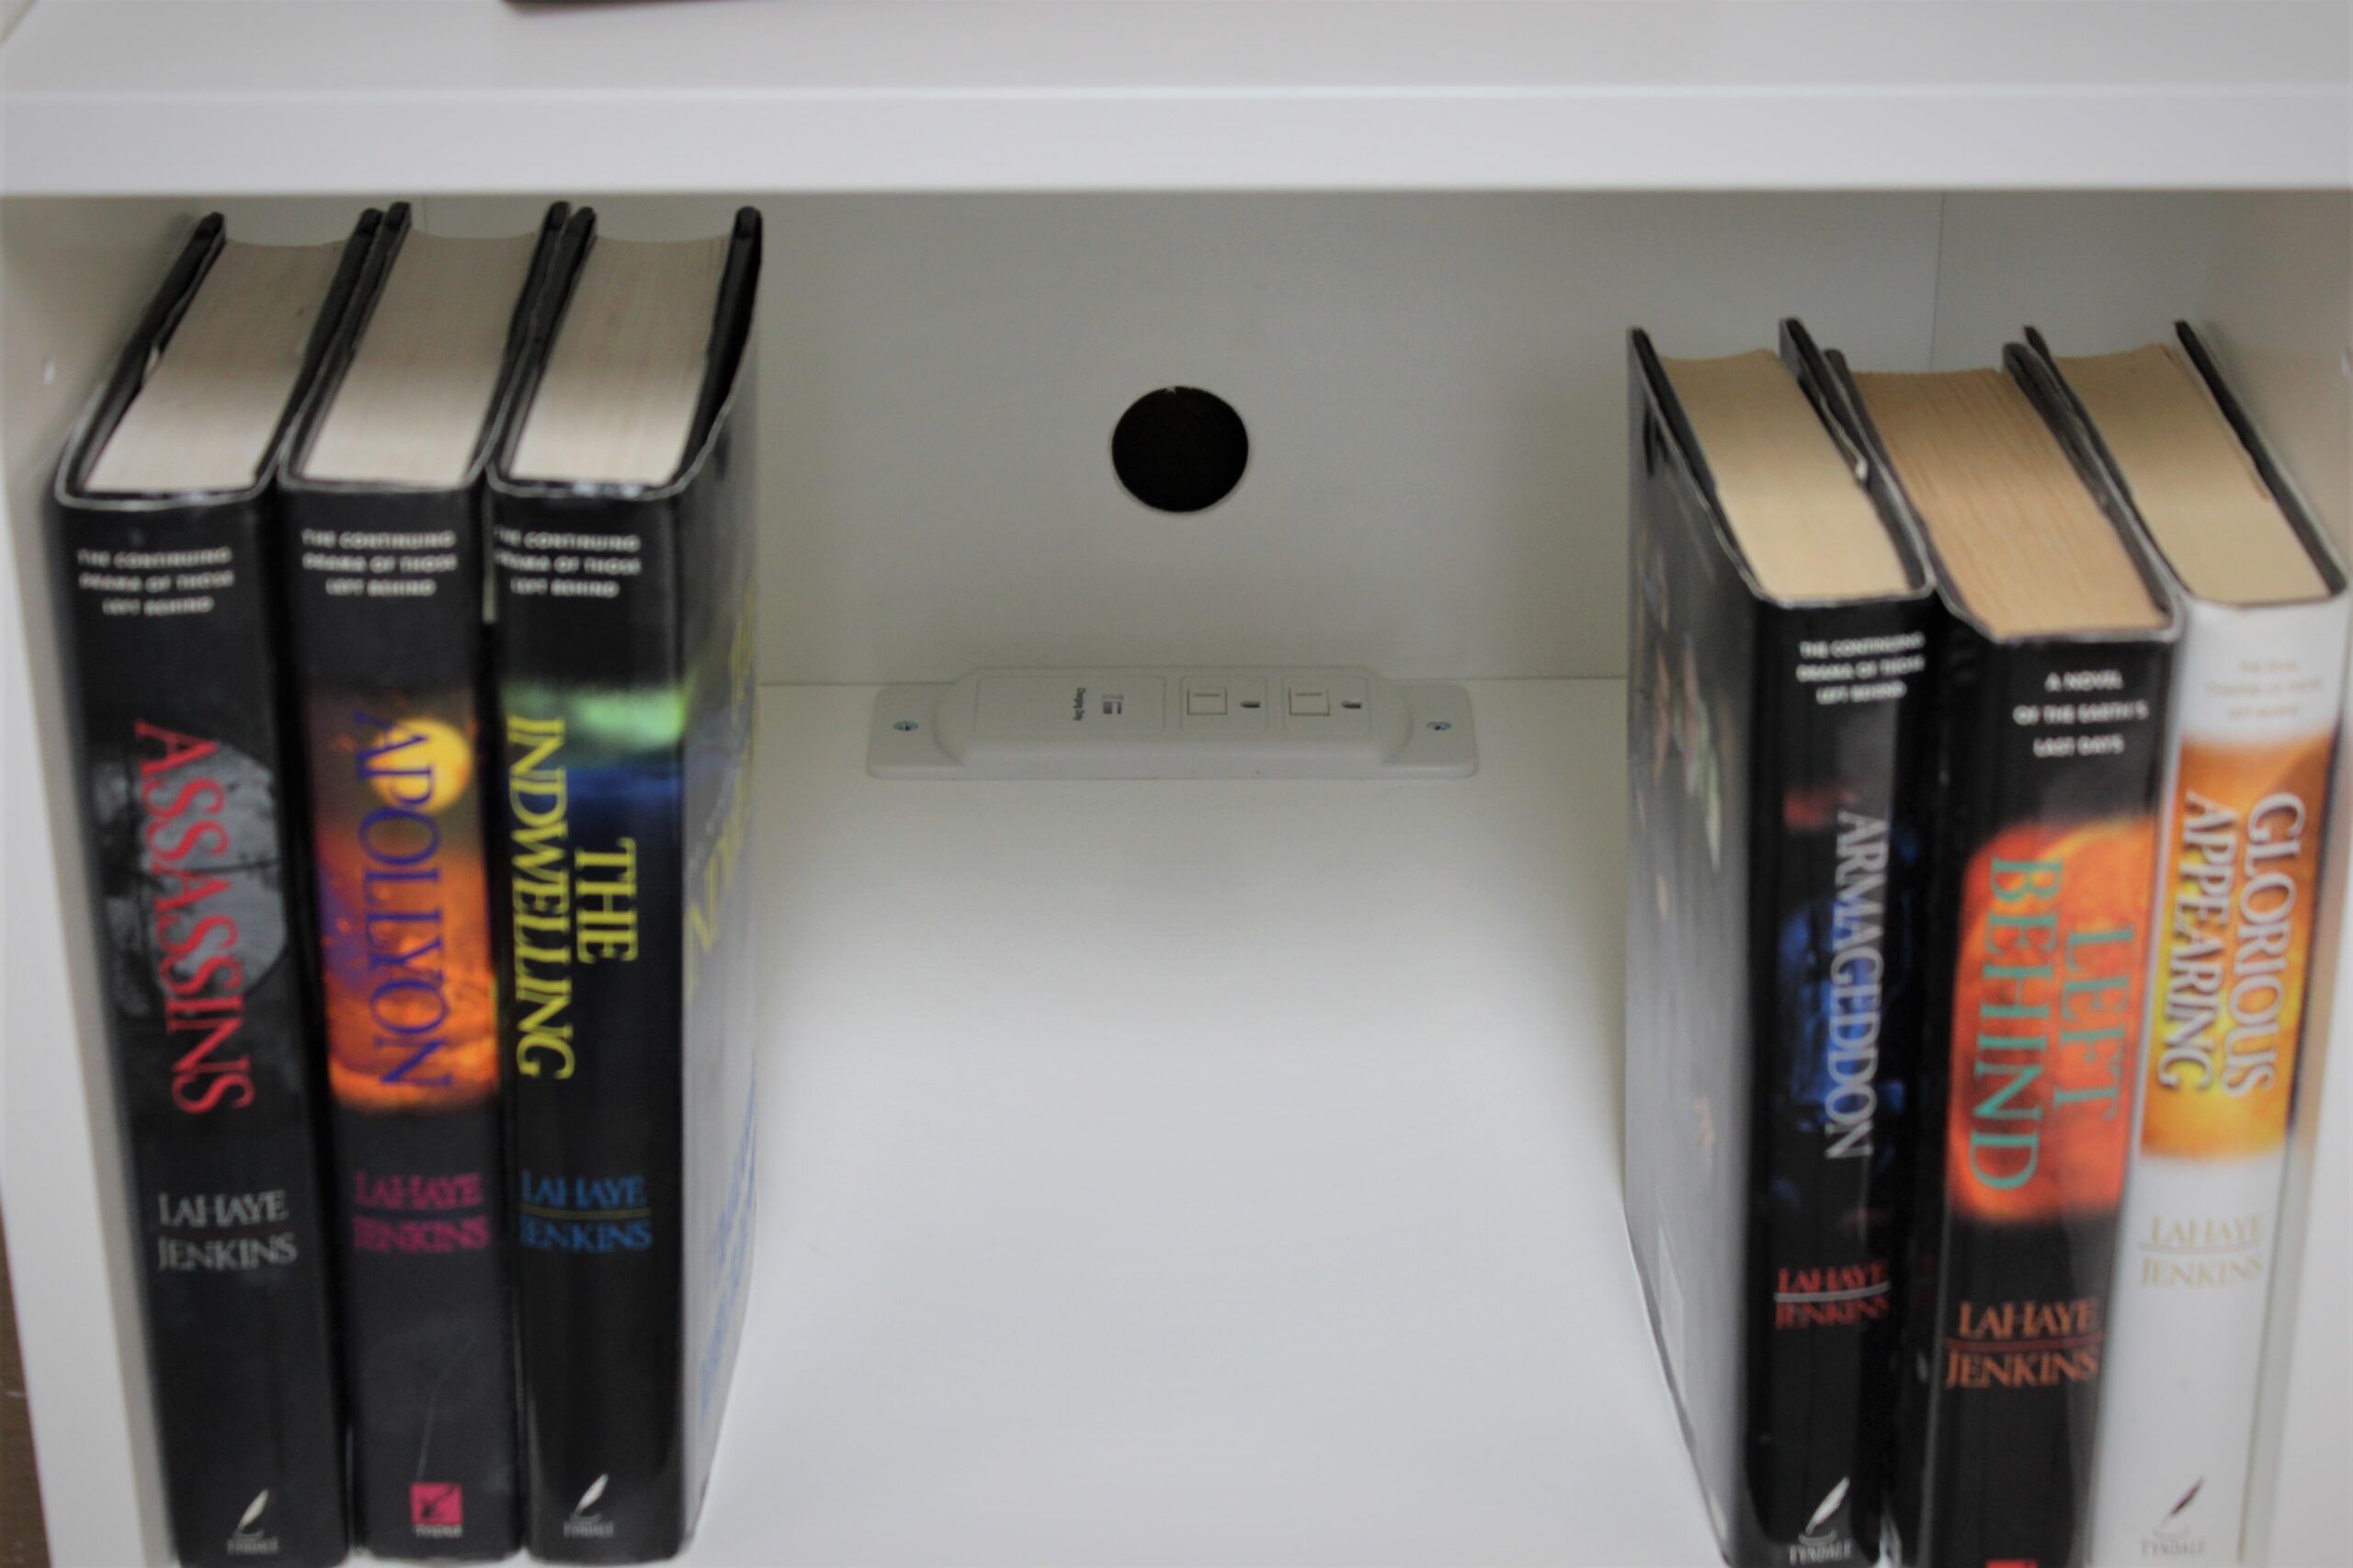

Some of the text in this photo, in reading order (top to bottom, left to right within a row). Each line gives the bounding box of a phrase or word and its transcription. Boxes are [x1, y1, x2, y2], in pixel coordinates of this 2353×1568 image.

[144, 575, 172, 593] OF
[176, 570, 235, 590] THOSE
[369, 555, 396, 574] OF
[399, 554, 458, 574] THOSE
[553, 555, 580, 574] OF
[584, 558, 642, 575] THOSE
[143, 597, 214, 617] BEHIND
[367, 579, 438, 597] BEHIND
[550, 579, 620, 598] BEHIND
[1855, 661, 1879, 679] OF
[1880, 653, 1927, 676] THOSE
[2043, 668, 2125, 692] A NOVEL
[1850, 679, 1908, 703] BEHIND
[2012, 704, 2040, 726] OF
[2043, 703, 2075, 725] THE
[2032, 733, 2126, 758] LAST DAYS
[133, 719, 256, 1113] ASSASSINS
[353, 710, 452, 1088] APOLLYON
[506, 714, 575, 1080] INDWELLING
[574, 837, 639, 964] THE
[2158, 790, 2237, 1090] APPEARING
[2222, 791, 2306, 1098] GLORIOUS
[1823, 810, 1890, 1161] ARMAGEDDON
[1968, 857, 2063, 1191] BEHIND
[2053, 926, 2135, 1120] LEFT
[157, 1233, 298, 1272] JENKINS
[353, 1215, 491, 1254] JENKINS
[519, 1215, 654, 1253] JENKINS
[1945, 1346, 2101, 1390] JENKINS
